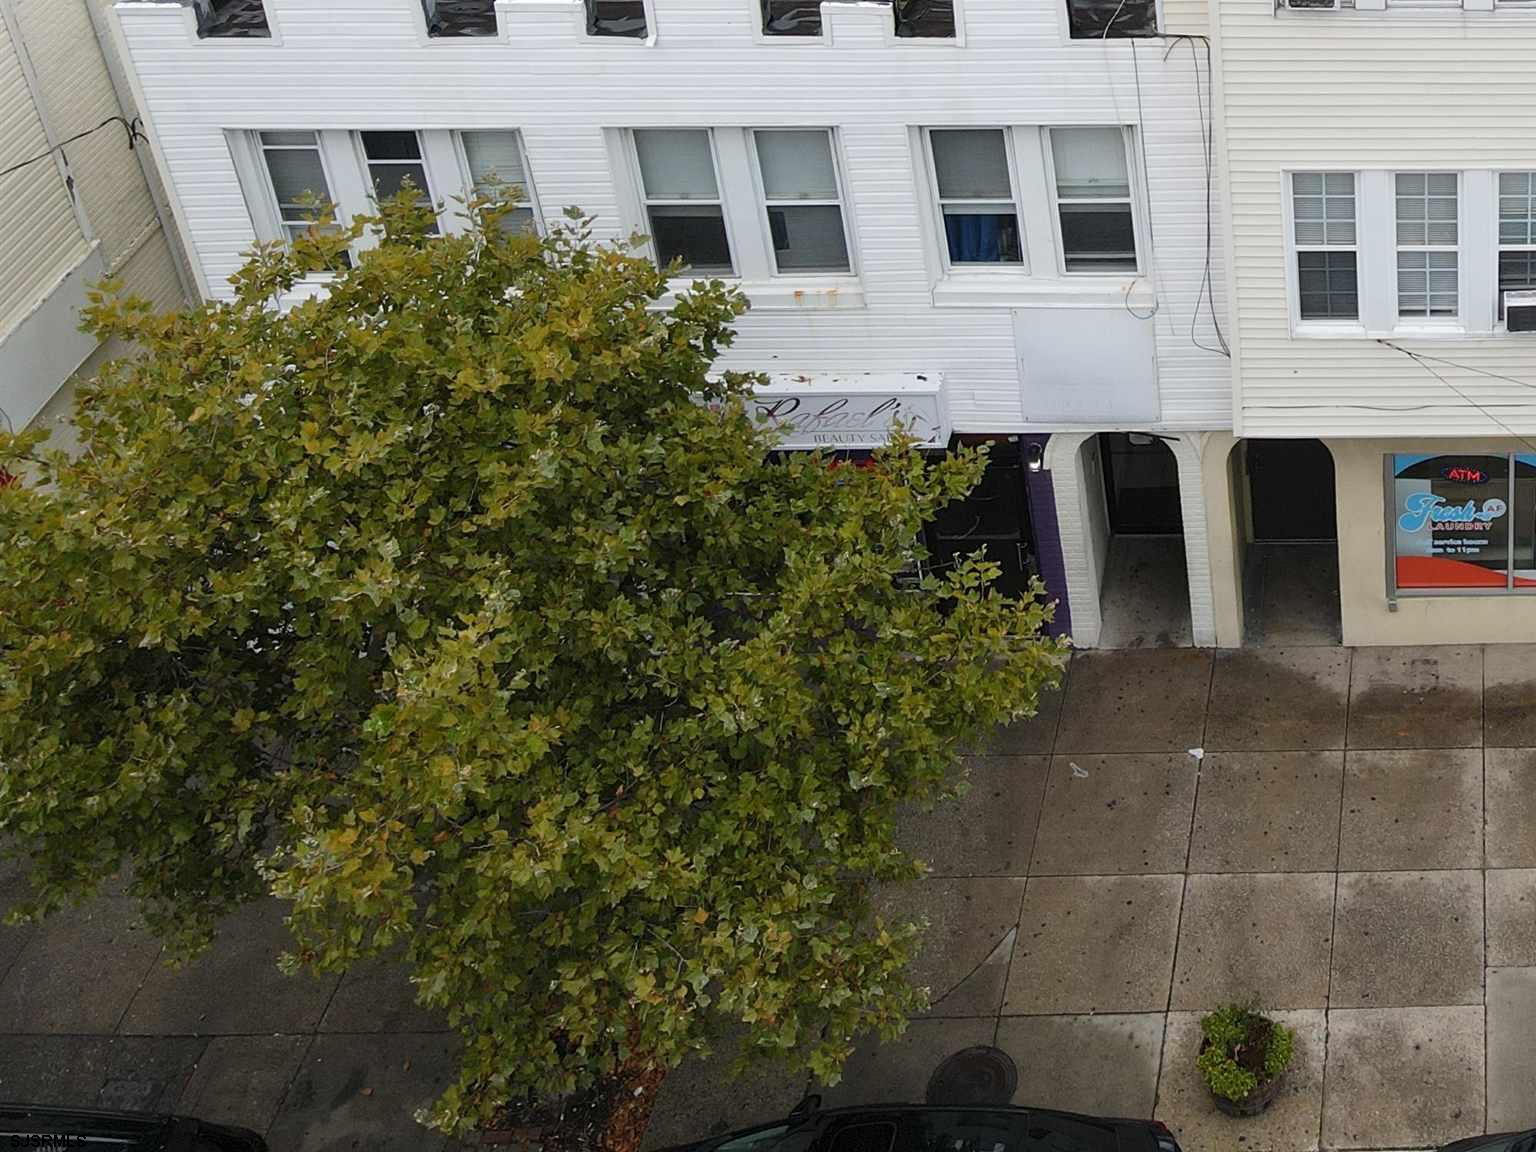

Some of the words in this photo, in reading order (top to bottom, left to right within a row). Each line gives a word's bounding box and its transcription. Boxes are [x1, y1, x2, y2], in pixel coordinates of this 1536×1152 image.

[814, 432, 865, 444] BEAUTY
[1449, 468, 1481, 483] ATM
[1399, 492, 1478, 533] Fresh
[1428, 521, 1494, 532] LAUNDRY
